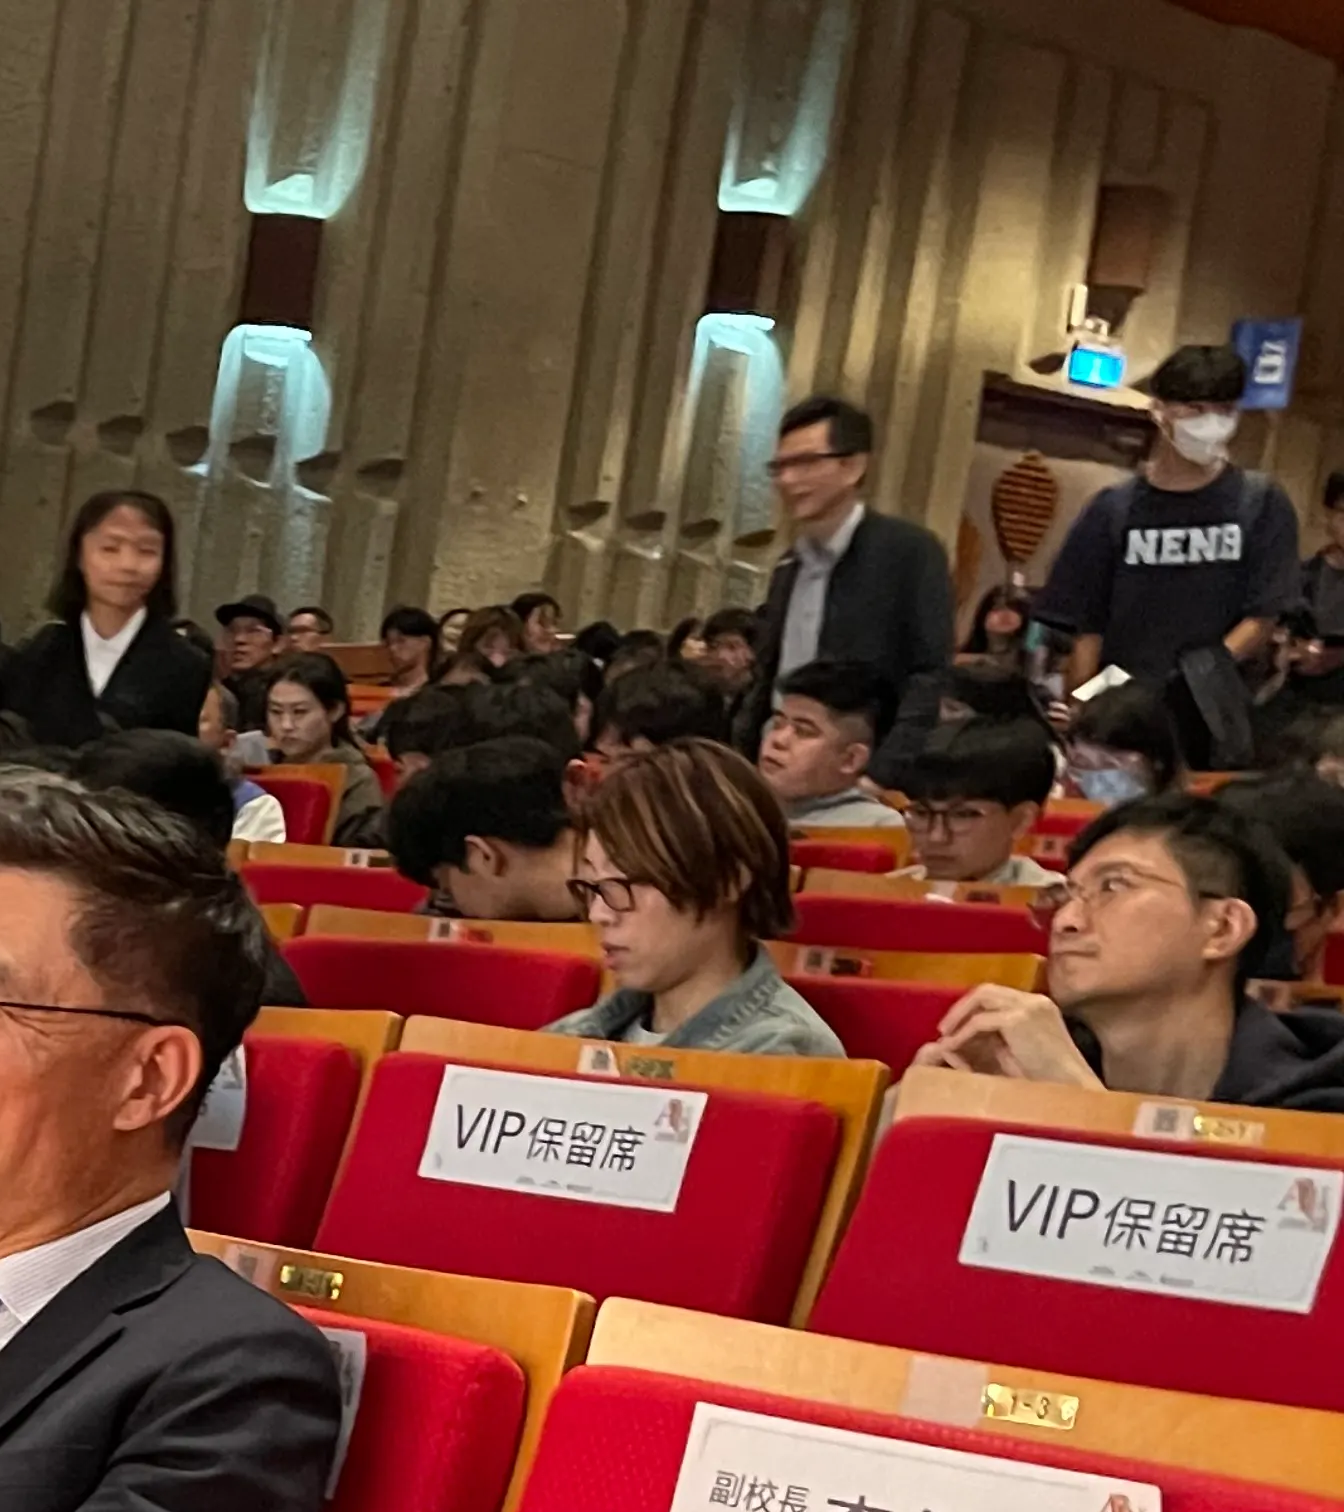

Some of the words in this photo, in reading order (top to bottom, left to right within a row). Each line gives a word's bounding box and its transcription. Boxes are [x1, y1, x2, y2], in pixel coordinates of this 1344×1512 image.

[457, 1104, 646, 1173] VIP保留席
[1007, 1179, 1266, 1264] VIP保留席
[1010, 1392, 1051, 1420] 1-3
